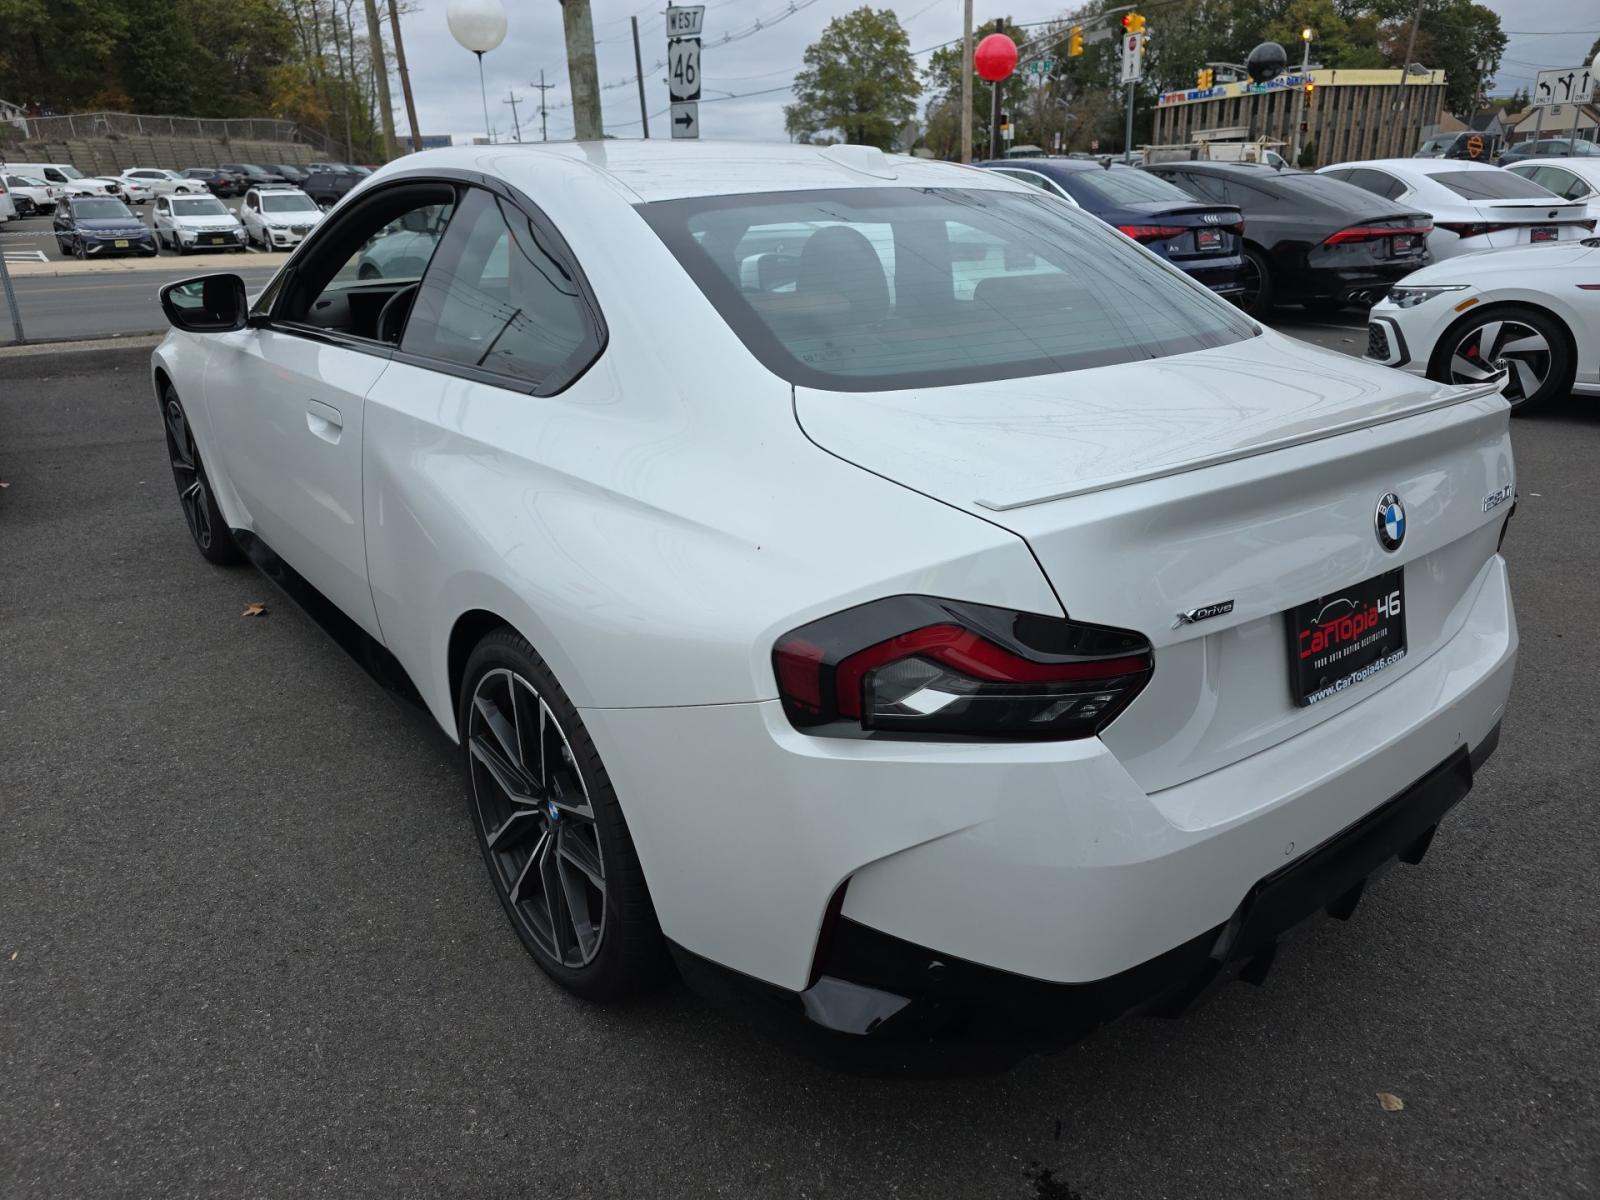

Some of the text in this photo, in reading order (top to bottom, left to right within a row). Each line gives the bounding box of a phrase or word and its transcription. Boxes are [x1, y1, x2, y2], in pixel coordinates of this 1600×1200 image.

[670, 11, 699, 30] WEST
[674, 52, 695, 86] 46
[1308, 650, 1405, 704] www.CarTopia46.com
